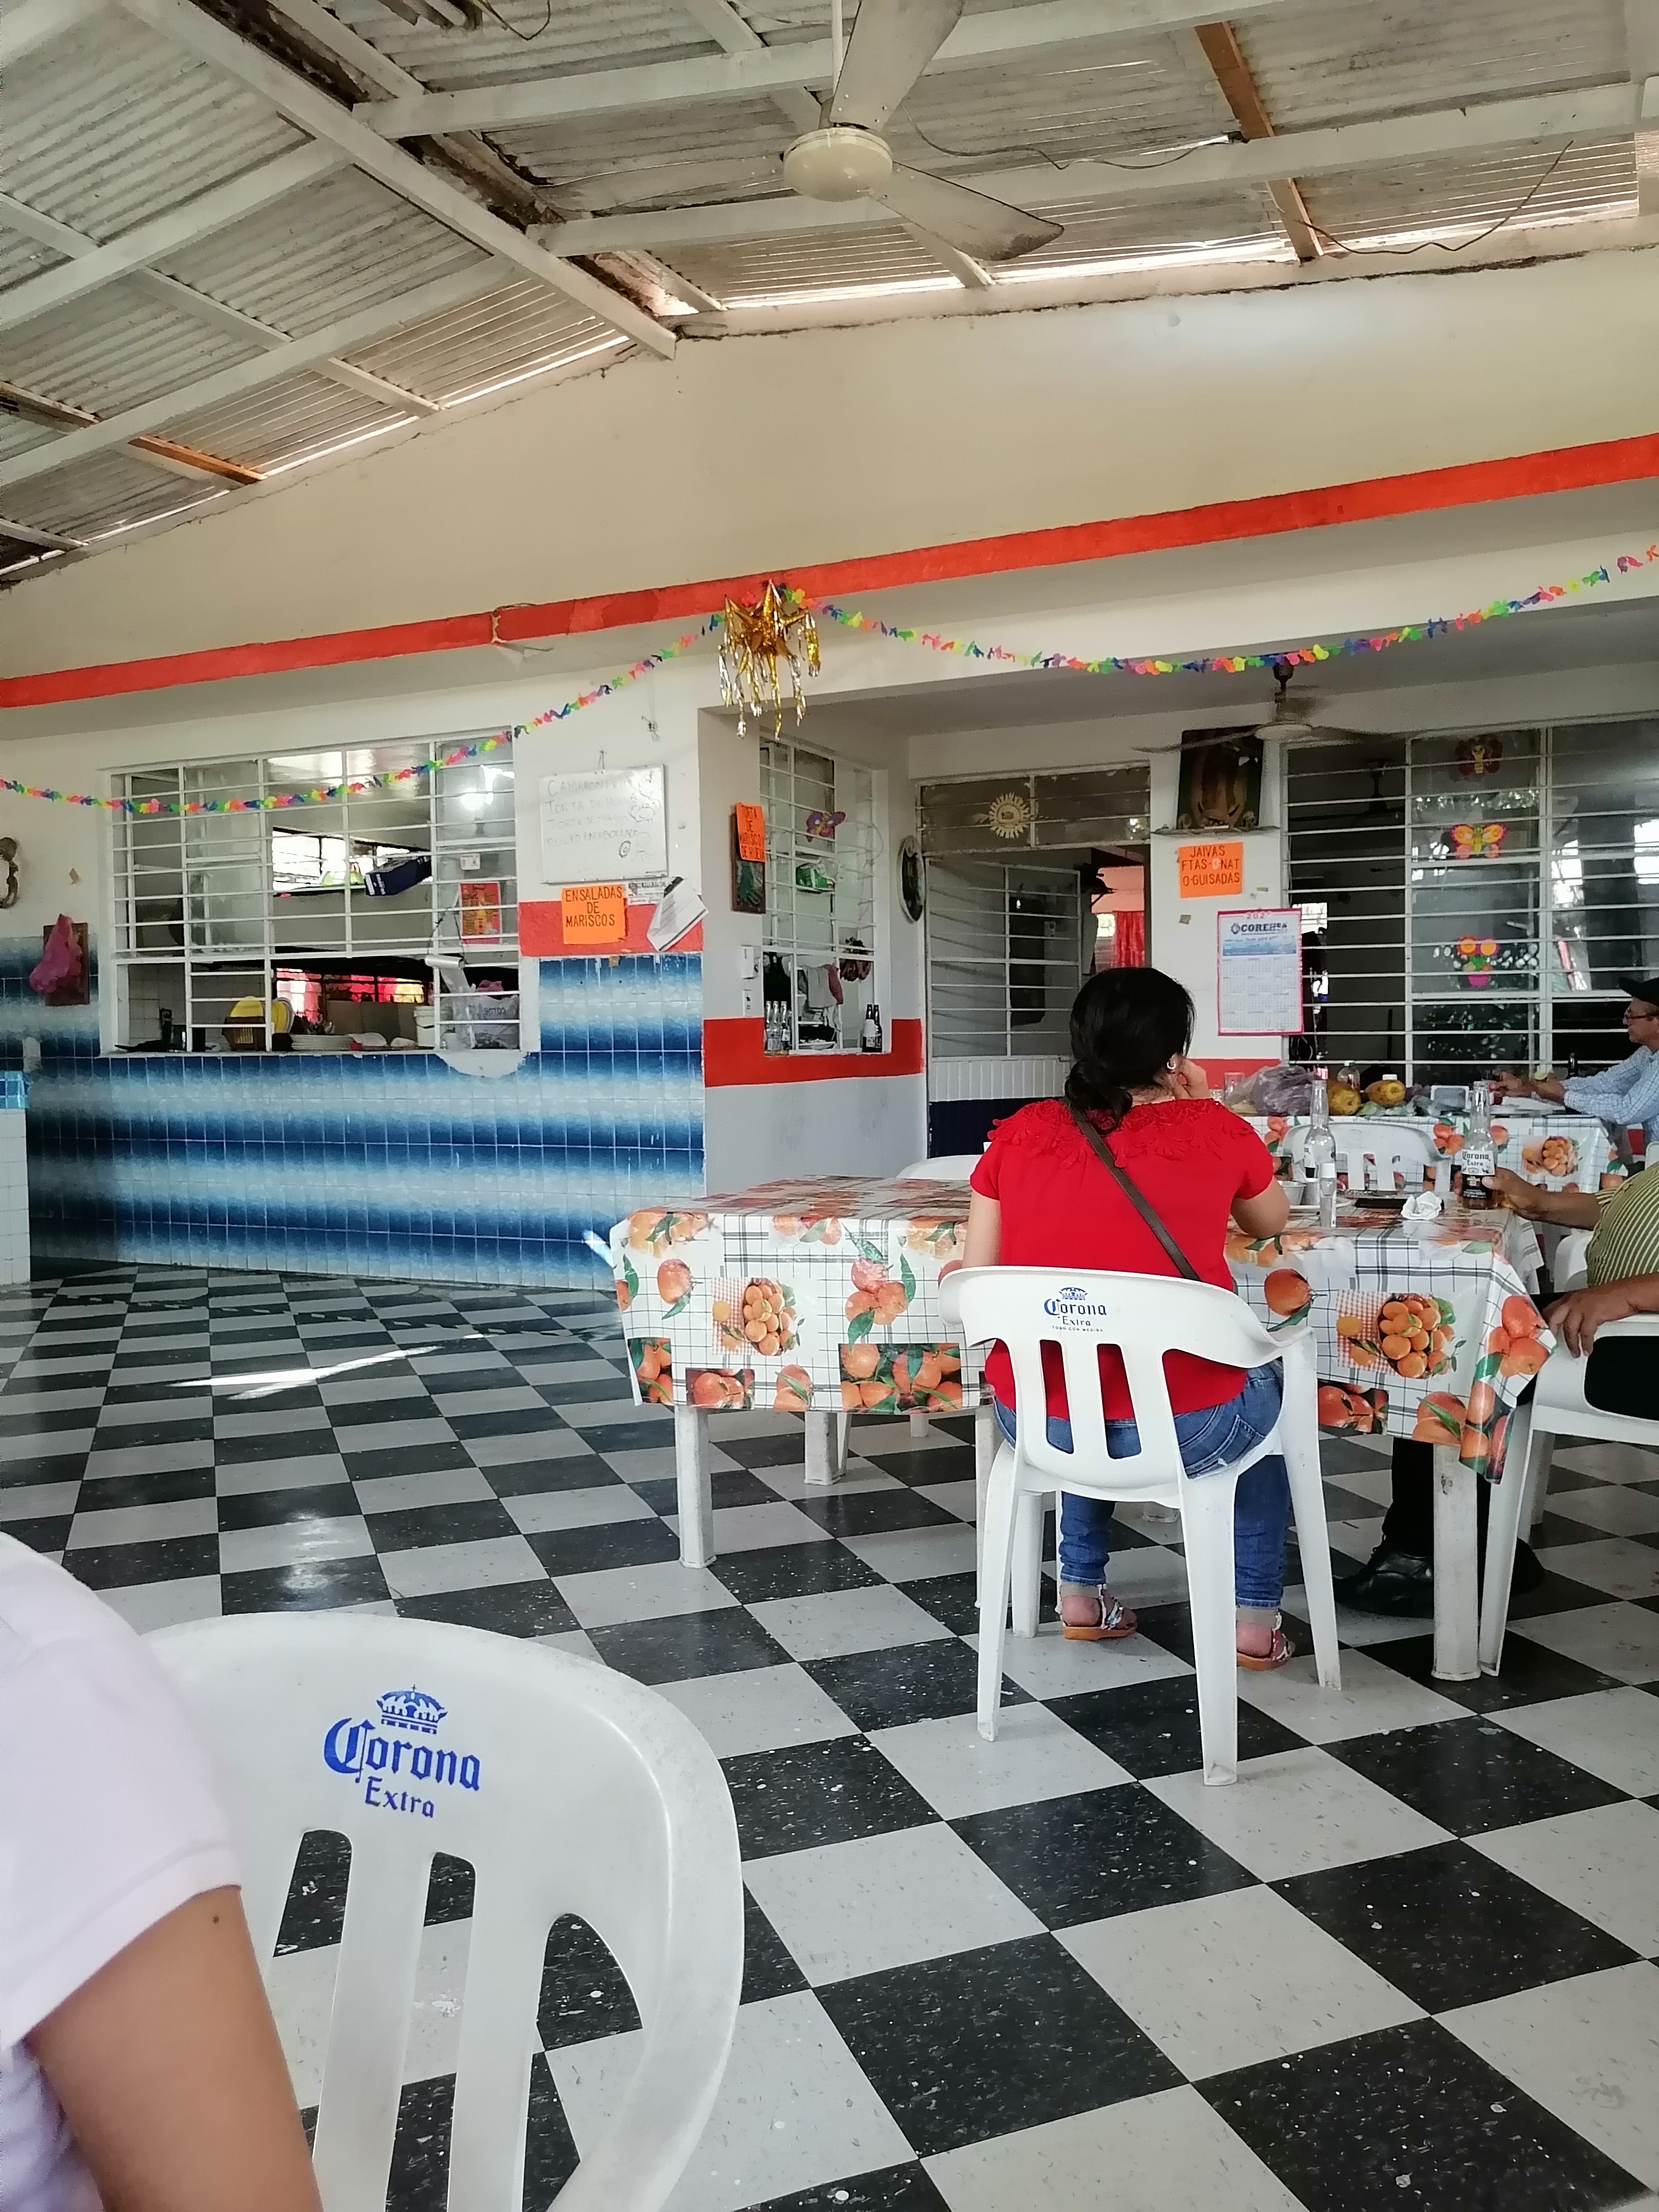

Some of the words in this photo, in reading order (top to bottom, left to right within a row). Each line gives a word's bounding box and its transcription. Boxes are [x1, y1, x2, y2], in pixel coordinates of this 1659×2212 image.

[545, 800, 584, 814] TORTA
[589, 800, 602, 808] DE
[547, 818, 582, 830] TORTA
[746, 819, 754, 833] DE
[1191, 845, 1225, 858] JAIVAS
[566, 886, 623, 902] ENSALADAS
[587, 901, 599, 914] DE
[566, 914, 615, 927] MARISCOS
[1462, 1151, 1490, 1161] Corona
[1044, 1298, 1107, 1318] Corona
[1062, 1316, 1091, 1326] Extra
[324, 1718, 481, 1791] Corona
[364, 1776, 435, 1818] Extra
